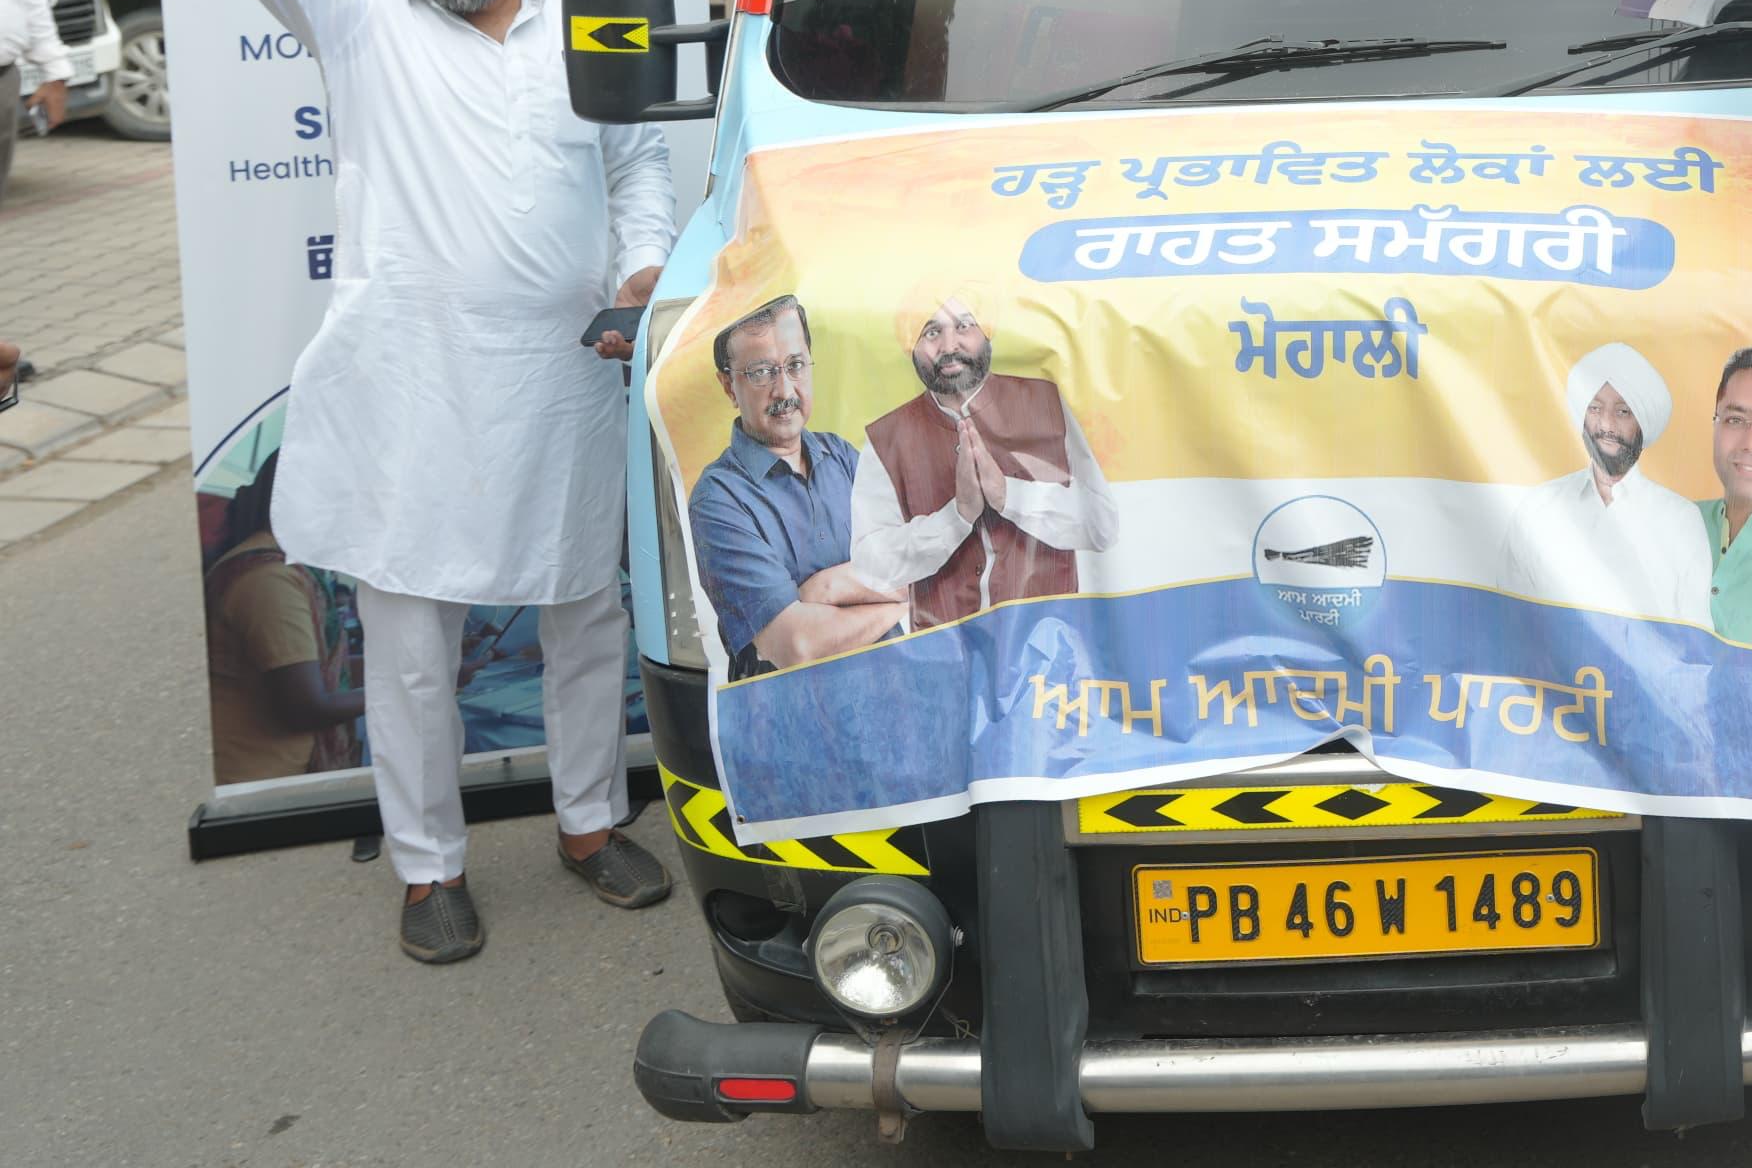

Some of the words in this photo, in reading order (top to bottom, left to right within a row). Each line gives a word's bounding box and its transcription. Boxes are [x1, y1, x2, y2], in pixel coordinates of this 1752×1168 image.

[1120, 140, 1390, 200] ਪ੍ਰਭਾਵਿਤ
[1407, 139, 1554, 185] ਲੋਕਾਂ
[1573, 146, 1725, 193] ਲਈ
[1074, 220, 1292, 270] ਰਾਹਤ
[1308, 207, 1627, 275] ਸਮੱਗਰੀ
[1228, 295, 1428, 380] ਮੋਹਾਲੀ
[1278, 589, 1306, 604] ਆਮ
[1312, 588, 1361, 607] ਆਦਮੀ
[1299, 609, 1340, 626] ਪਾਰਟੀ
[1030, 674, 1167, 737] ਆਮ
[1190, 652, 1401, 734] ਆਦਮੀ
[1423, 665, 1613, 746] ਪਾਰਟੀ
[1149, 907, 1182, 924] IND
[1186, 884, 1261, 943] PB
[1285, 879, 1355, 939] 46
[1376, 877, 1406, 936] W
[1434, 870, 1583, 932] 1489
